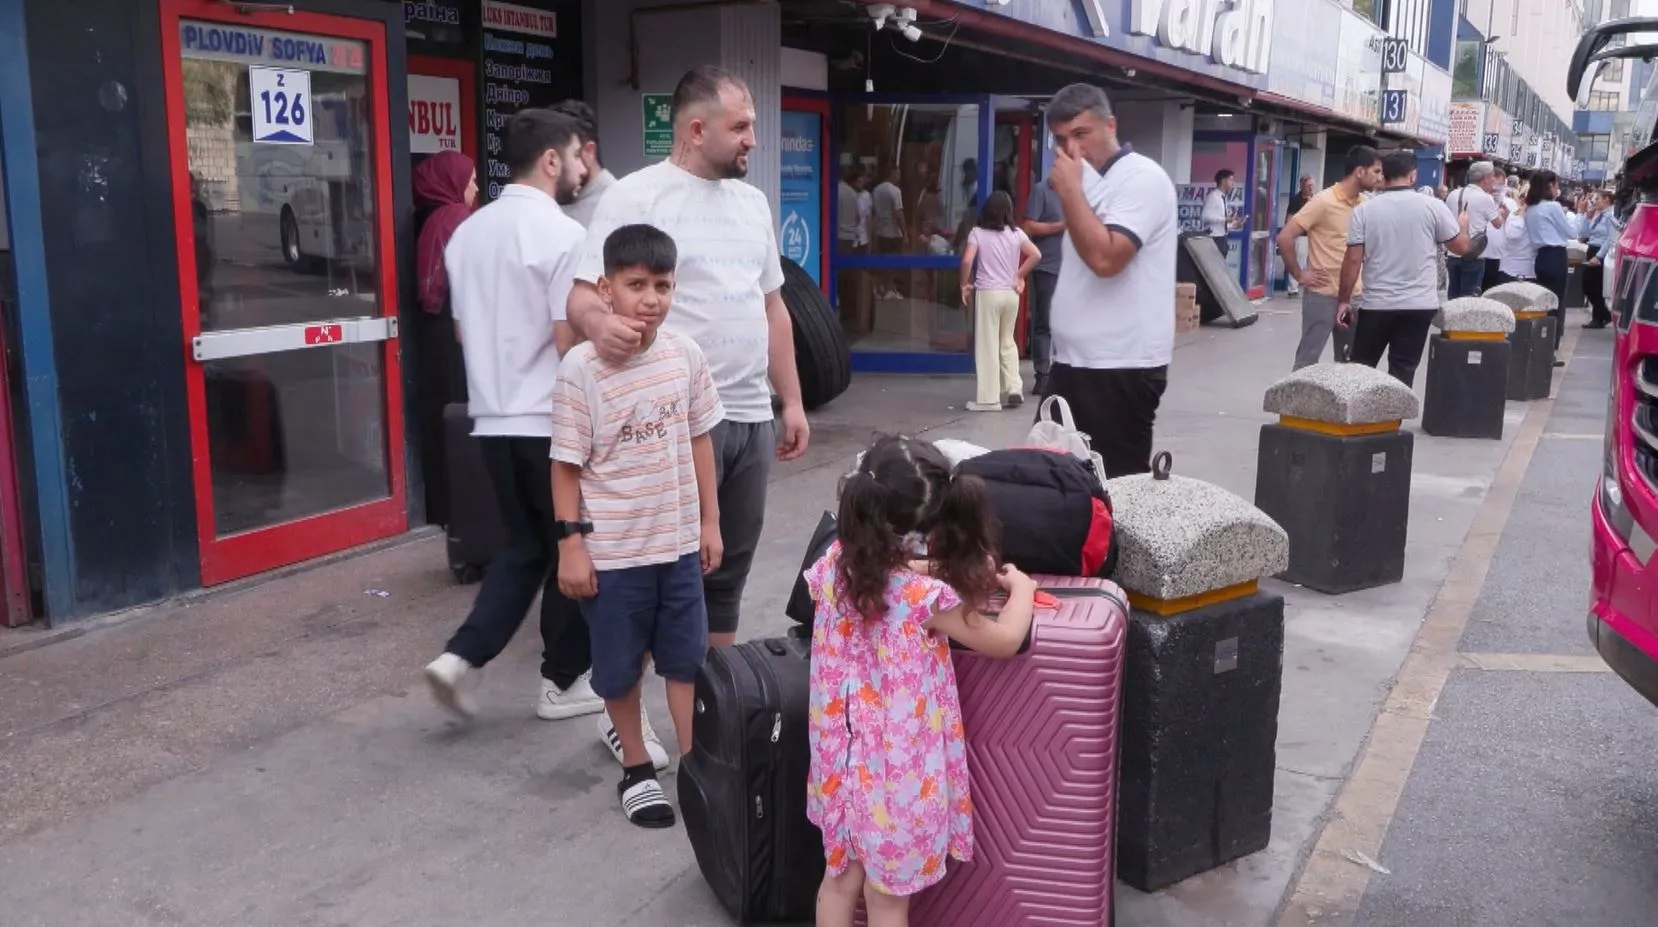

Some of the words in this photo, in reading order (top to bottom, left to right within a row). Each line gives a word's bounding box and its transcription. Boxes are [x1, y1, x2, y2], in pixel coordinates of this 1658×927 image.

[540, 15, 554, 32] TUR
[272, 37, 326, 65] SOFYA
[1383, 41, 1407, 70] 130
[276, 73, 285, 86] Z
[261, 90, 305, 125] 126
[1382, 92, 1405, 121] 131
[439, 138, 457, 149] TUR
[1484, 134, 1498, 152] 133
[621, 421, 668, 444] BASE
